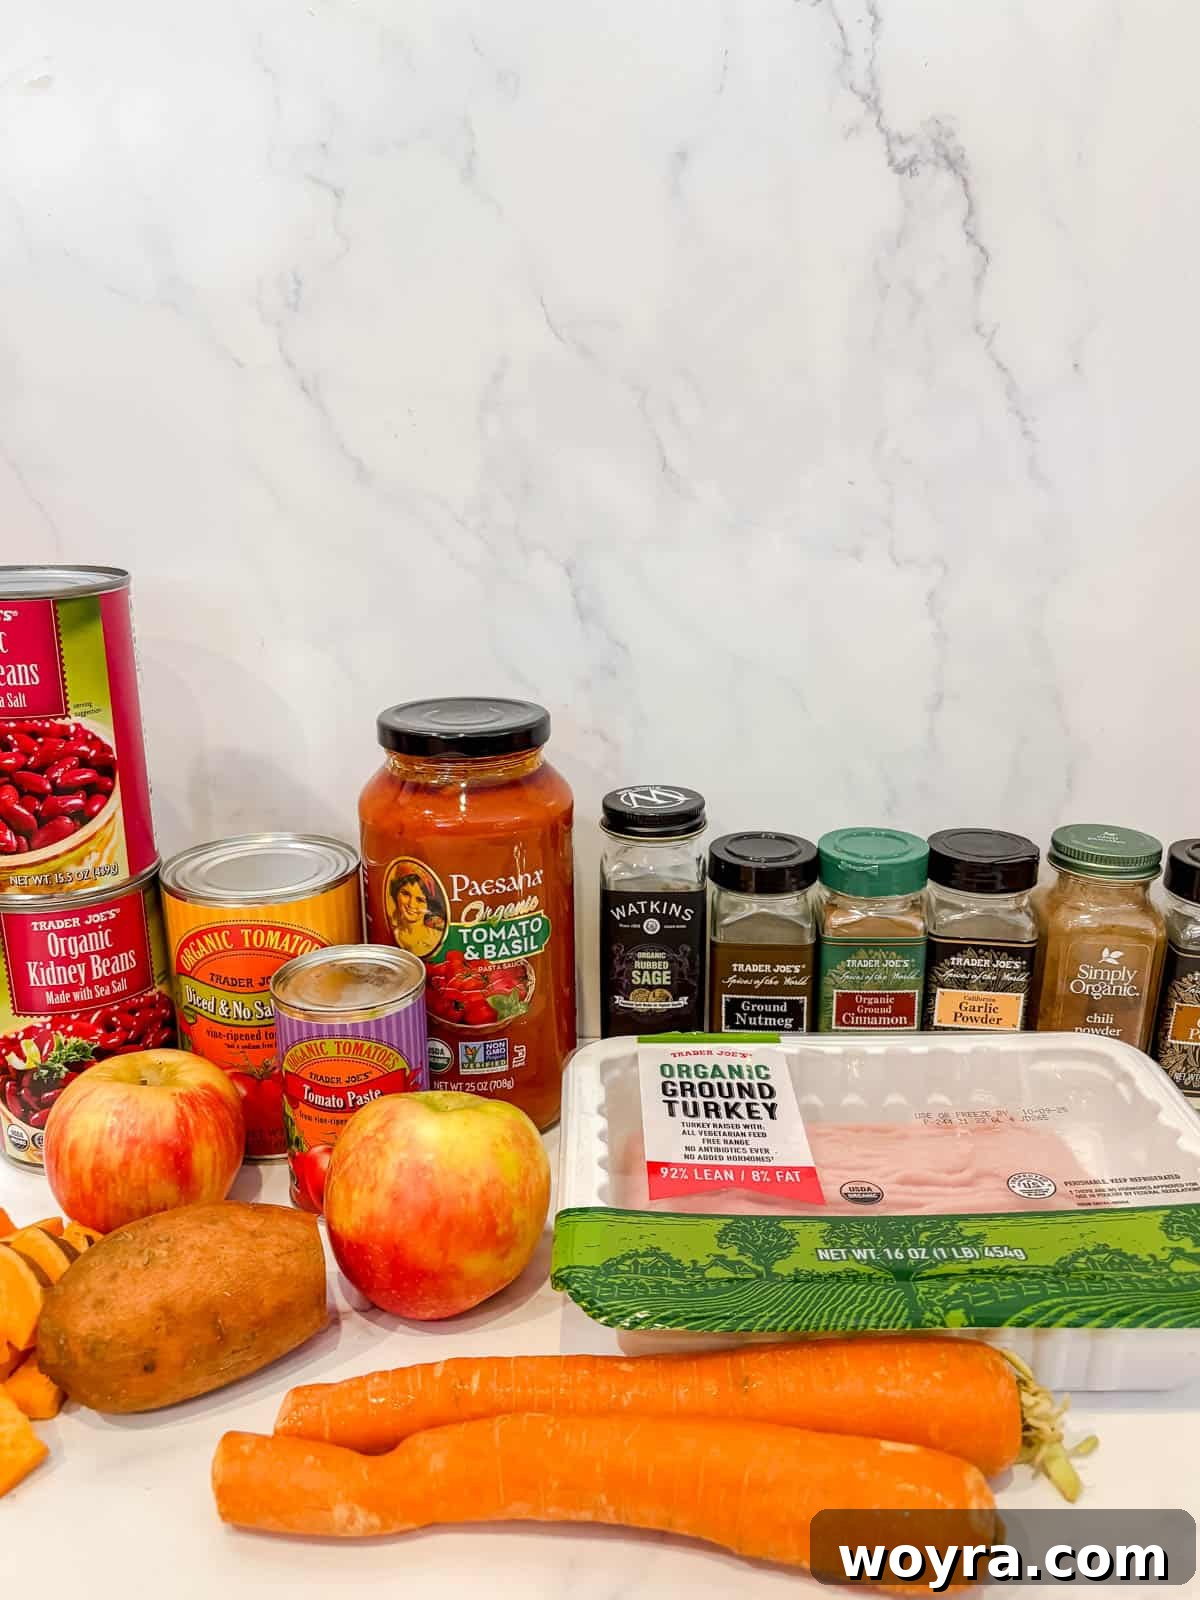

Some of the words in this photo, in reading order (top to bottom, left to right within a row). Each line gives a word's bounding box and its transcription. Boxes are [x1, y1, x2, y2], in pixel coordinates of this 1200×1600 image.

[0, 663, 40, 687] eans
[7, 691, 28, 709] Salt
[10, 876, 32, 886] NET
[54, 873, 75, 885] 15.5
[75, 870, 90, 882] OZ
[449, 870, 543, 901] Paesana
[461, 896, 539, 923] Organic
[610, 900, 694, 921] WATKINS
[32, 917, 81, 932] TRADER
[84, 908, 120, 926] JOE'S
[458, 918, 542, 944] TOMATO
[47, 925, 113, 960] Organic
[181, 930, 233, 970] ORGANIC
[240, 929, 321, 956] TOMATO
[464, 946, 480, 961] &
[484, 936, 538, 960] BASIL
[637, 952, 667, 960] ORGANIC
[846, 959, 880, 968] TRADER
[882, 959, 910, 968] JOE'S
[950, 957, 990, 968] TRADER
[992, 960, 1021, 969] JOE'S
[25, 961, 86, 987] Kidney
[90, 950, 137, 981] Beans
[478, 964, 501, 973] PASTA
[634, 961, 669, 970] RUBBED
[731, 963, 772, 973] TRADER
[773, 964, 801, 974] JOE'S
[209, 973, 254, 988] TRADER
[631, 970, 671, 985] SAGE
[1078, 964, 1138, 986] Simply
[46, 990, 71, 1005] Made
[73, 985, 93, 1001] with
[94, 982, 110, 997] Sea
[112, 977, 128, 993] Salt
[185, 985, 215, 1014] Diced
[218, 999, 232, 1018] &
[233, 1002, 251, 1020] No
[255, 999, 275, 1019] Sal
[741, 1000, 788, 1013] Ground
[855, 994, 895, 1005] Organic
[856, 1005, 892, 1014] Ground
[959, 1001, 999, 1014] Garlic
[735, 1013, 794, 1029] Nutmeg
[841, 1012, 907, 1025] Cinnamon
[953, 1012, 1004, 1026] Powder
[1086, 1013, 1115, 1025] chili
[485, 1041, 505, 1050] NON
[485, 1047, 506, 1056] GMO
[287, 1041, 328, 1070] ORGANIC
[334, 1040, 399, 1070] TOMATOES
[670, 1050, 713, 1059] TRADER
[716, 1051, 751, 1059] JOE'S
[463, 1060, 506, 1070] VERIFIED
[309, 1072, 342, 1084] TRADER
[433, 1081, 449, 1091] NET
[465, 1081, 476, 1092] 25
[477, 1081, 489, 1091] OZ
[490, 1077, 514, 1092] (708g)
[302, 1084, 344, 1109] Tomato
[347, 1089, 382, 1107] Paste
[661, 1080, 777, 1100] GROUND
[662, 1099, 778, 1121] TURKEY
[914, 1112, 932, 1120] USE
[955, 1110, 991, 1119] FREEZE
[698, 1130, 746, 1138] VEGETARIAN
[699, 1146, 747, 1154] ANTIBIOTICS
[749, 1147, 770, 1155] EVER
[660, 1167, 688, 1180] 92%
[693, 1169, 734, 1181] LEAN
[741, 1170, 745, 1181] /
[751, 1170, 771, 1182] 8%
[775, 1171, 801, 1183] FAT
[1129, 1173, 1181, 1183] REFRIGERATED
[817, 1248, 847, 1260] NET
[883, 1248, 905, 1260] 16
[908, 1248, 927, 1260] OZ
[932, 1246, 946, 1260] (1
[953, 1246, 980, 1260] LB)
[984, 1246, 1026, 1261] 454g
